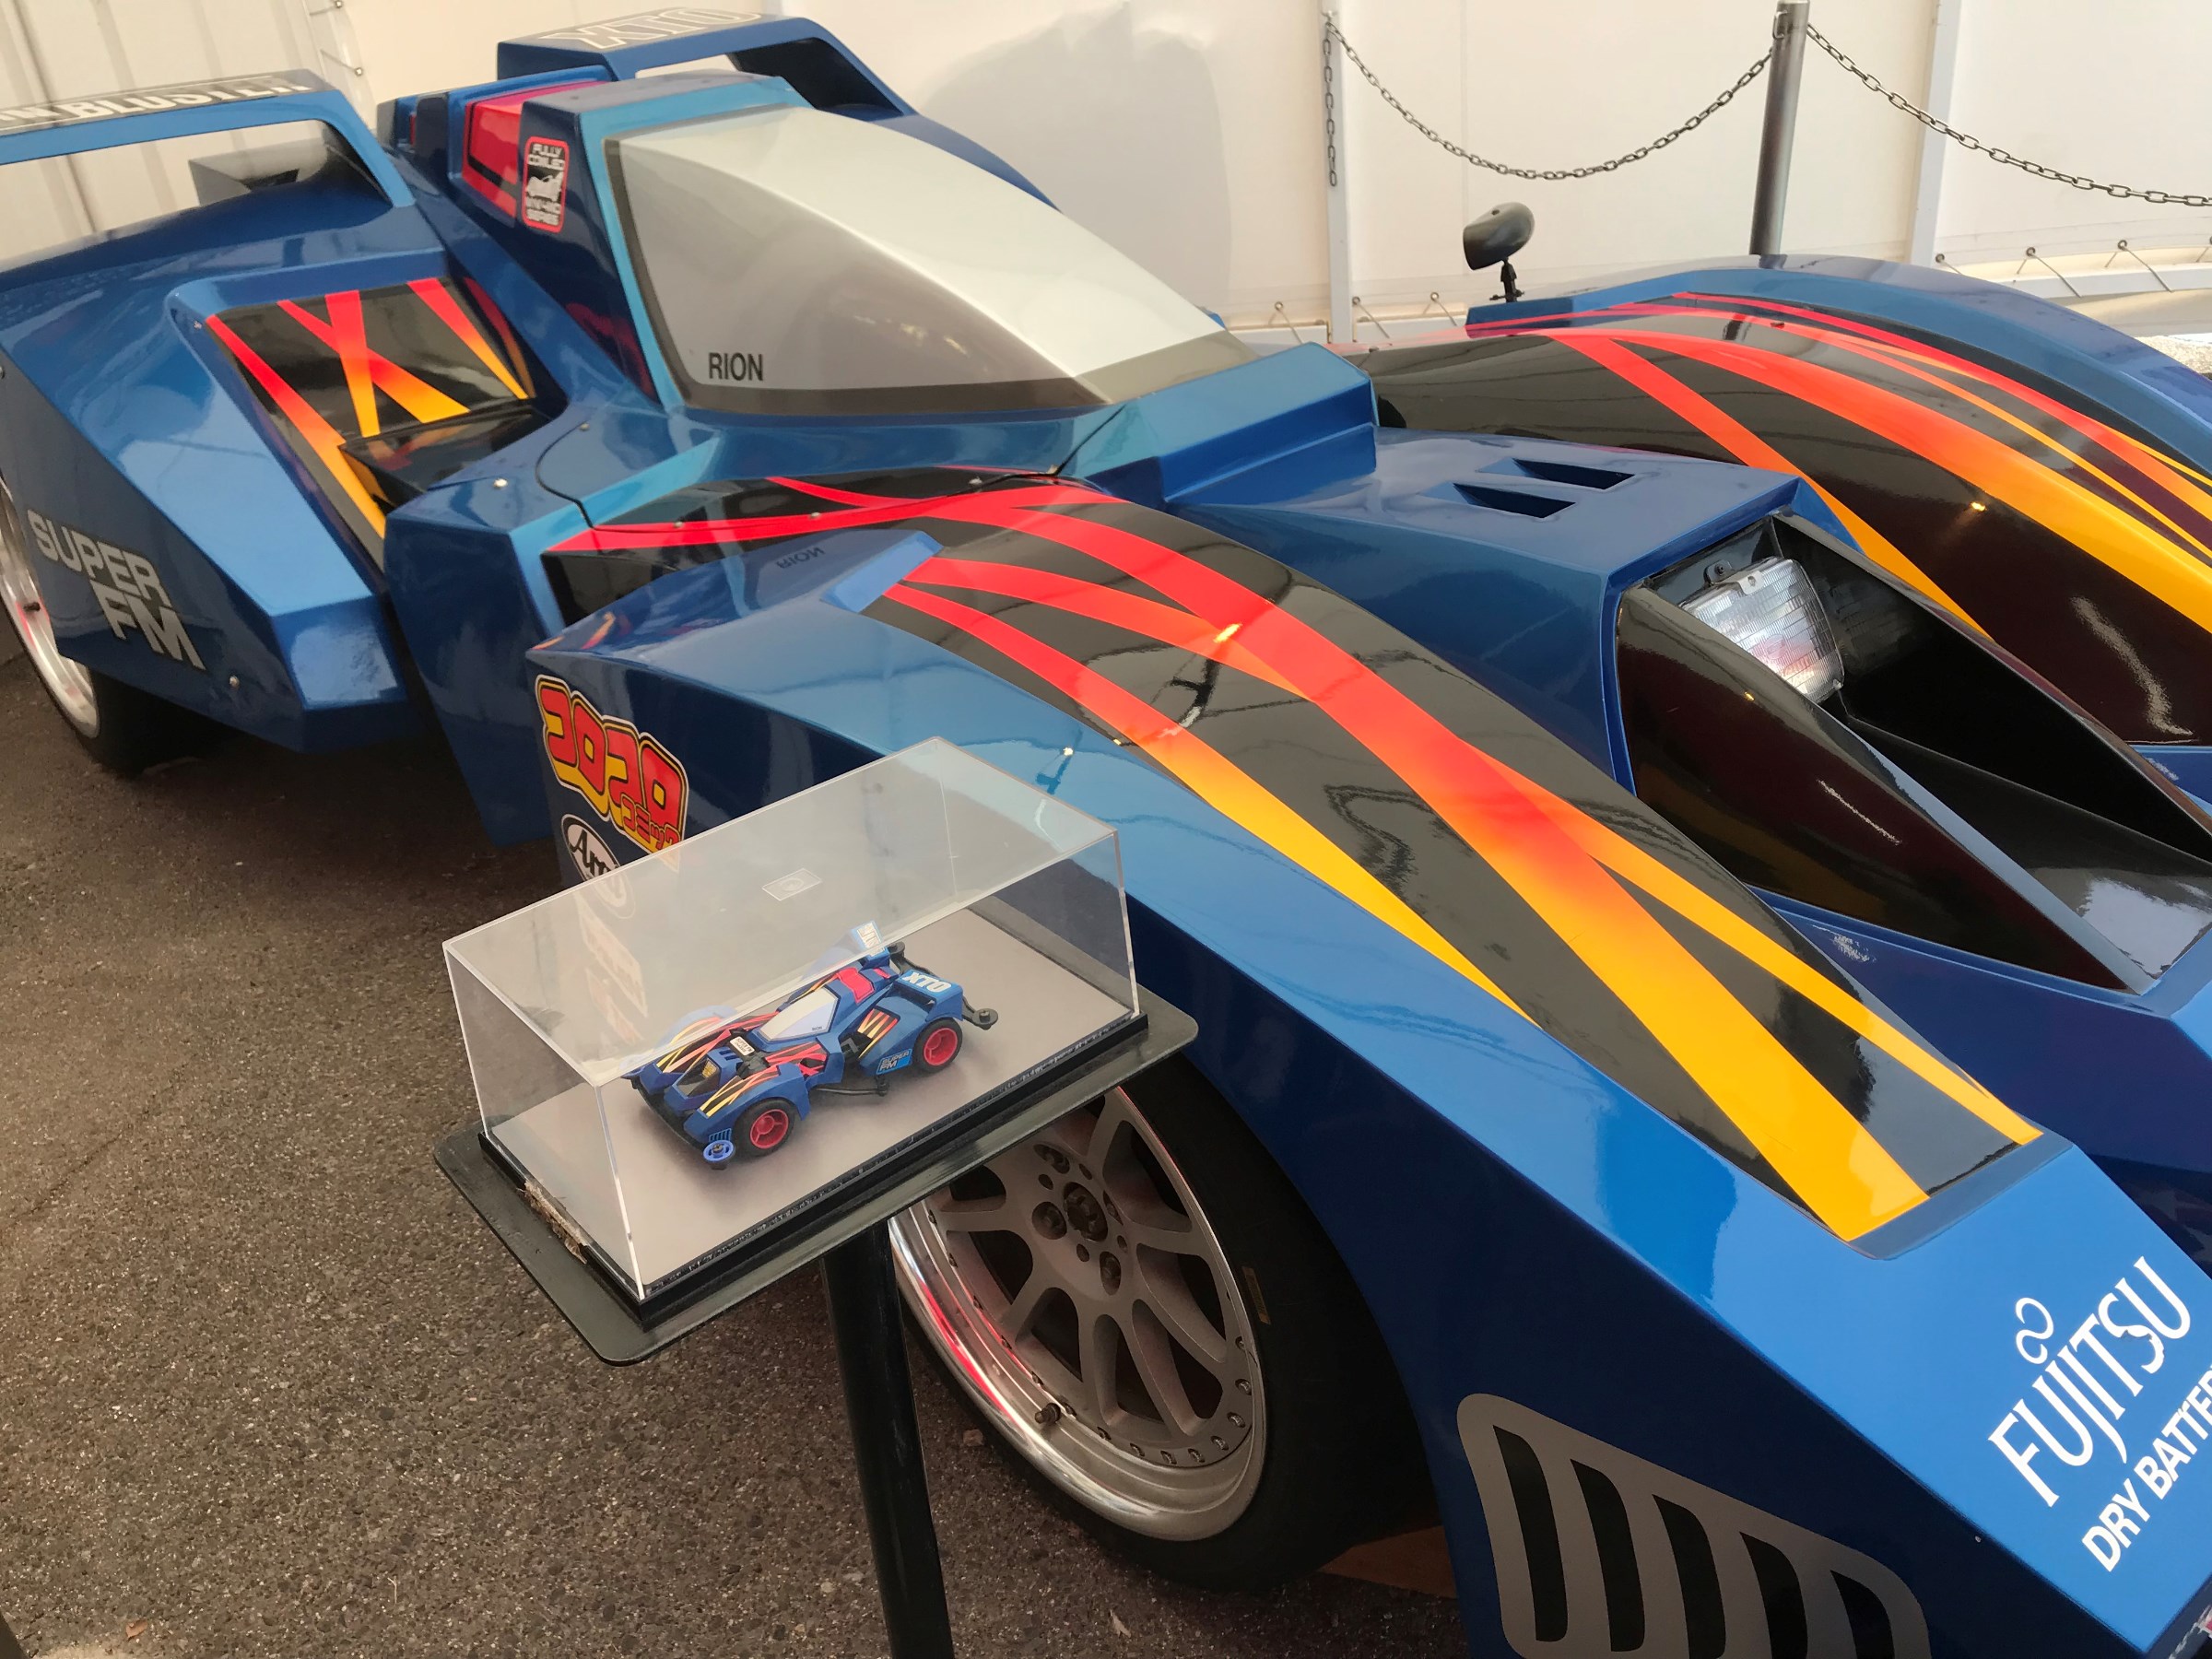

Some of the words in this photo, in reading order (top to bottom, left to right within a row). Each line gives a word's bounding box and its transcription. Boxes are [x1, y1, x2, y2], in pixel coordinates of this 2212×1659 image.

[537, 7, 762, 49] XTO
[53, 76, 312, 119] BLUSTER
[708, 352, 763, 382] RION
[27, 509, 172, 608] SUPER
[89, 579, 206, 671] FM
[901, 971, 952, 993] XTO
[879, 1059, 898, 1071] FM
[881, 1051, 910, 1064] SUPER
[1988, 1256, 2191, 1508] FUJITSU
[2081, 1478, 2150, 1571] DRY
[2134, 1362, 2212, 1500] BATTE
